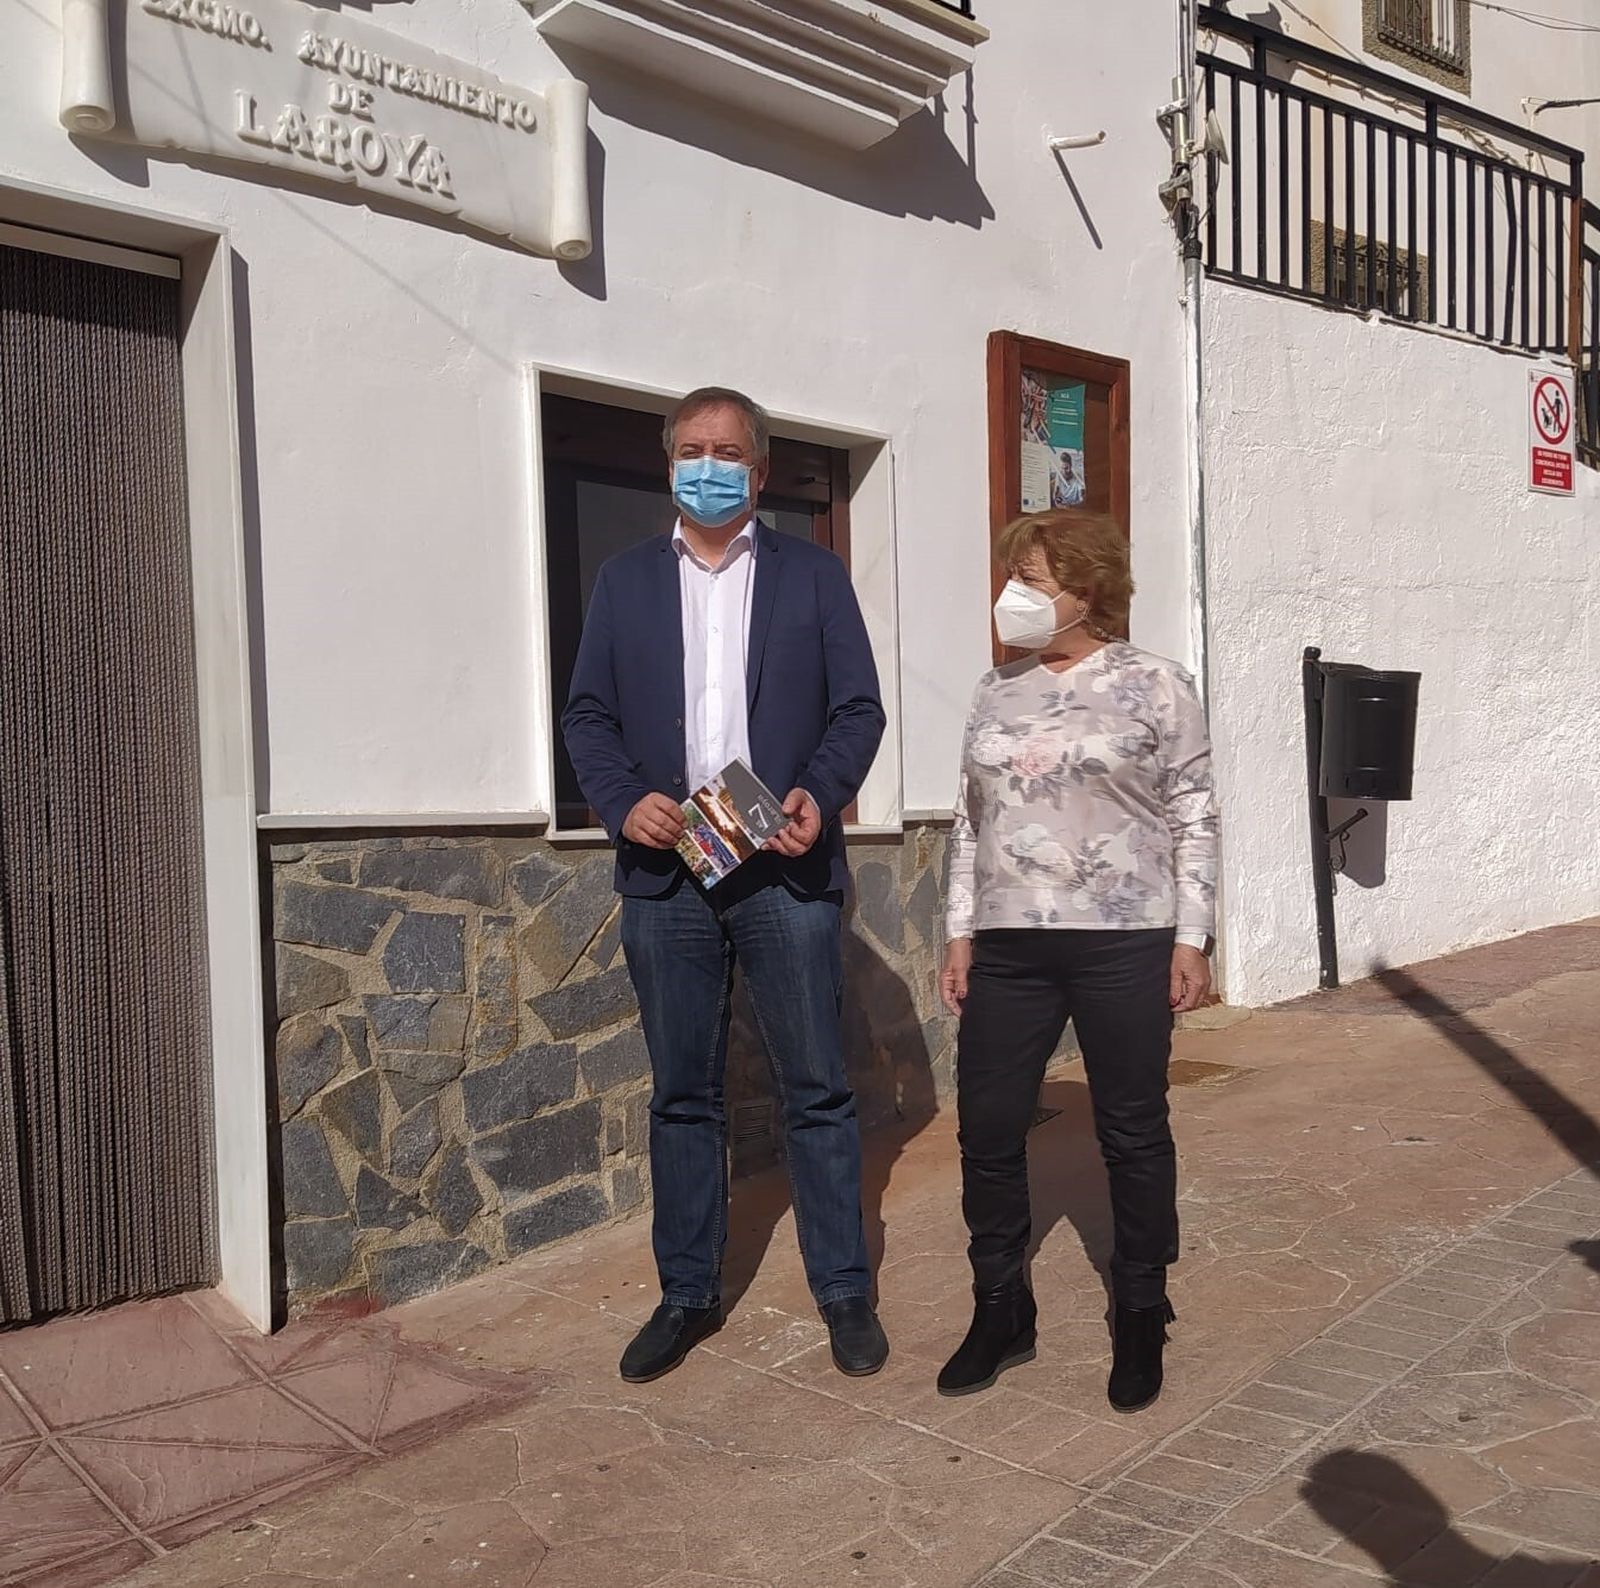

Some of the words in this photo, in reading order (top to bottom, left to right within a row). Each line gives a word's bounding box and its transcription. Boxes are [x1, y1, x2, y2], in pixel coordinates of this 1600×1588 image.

[297, 30, 537, 130] AYUNTAMIENTO
[327, 78, 374, 117] DE
[234, 88, 456, 194] LAROYA
